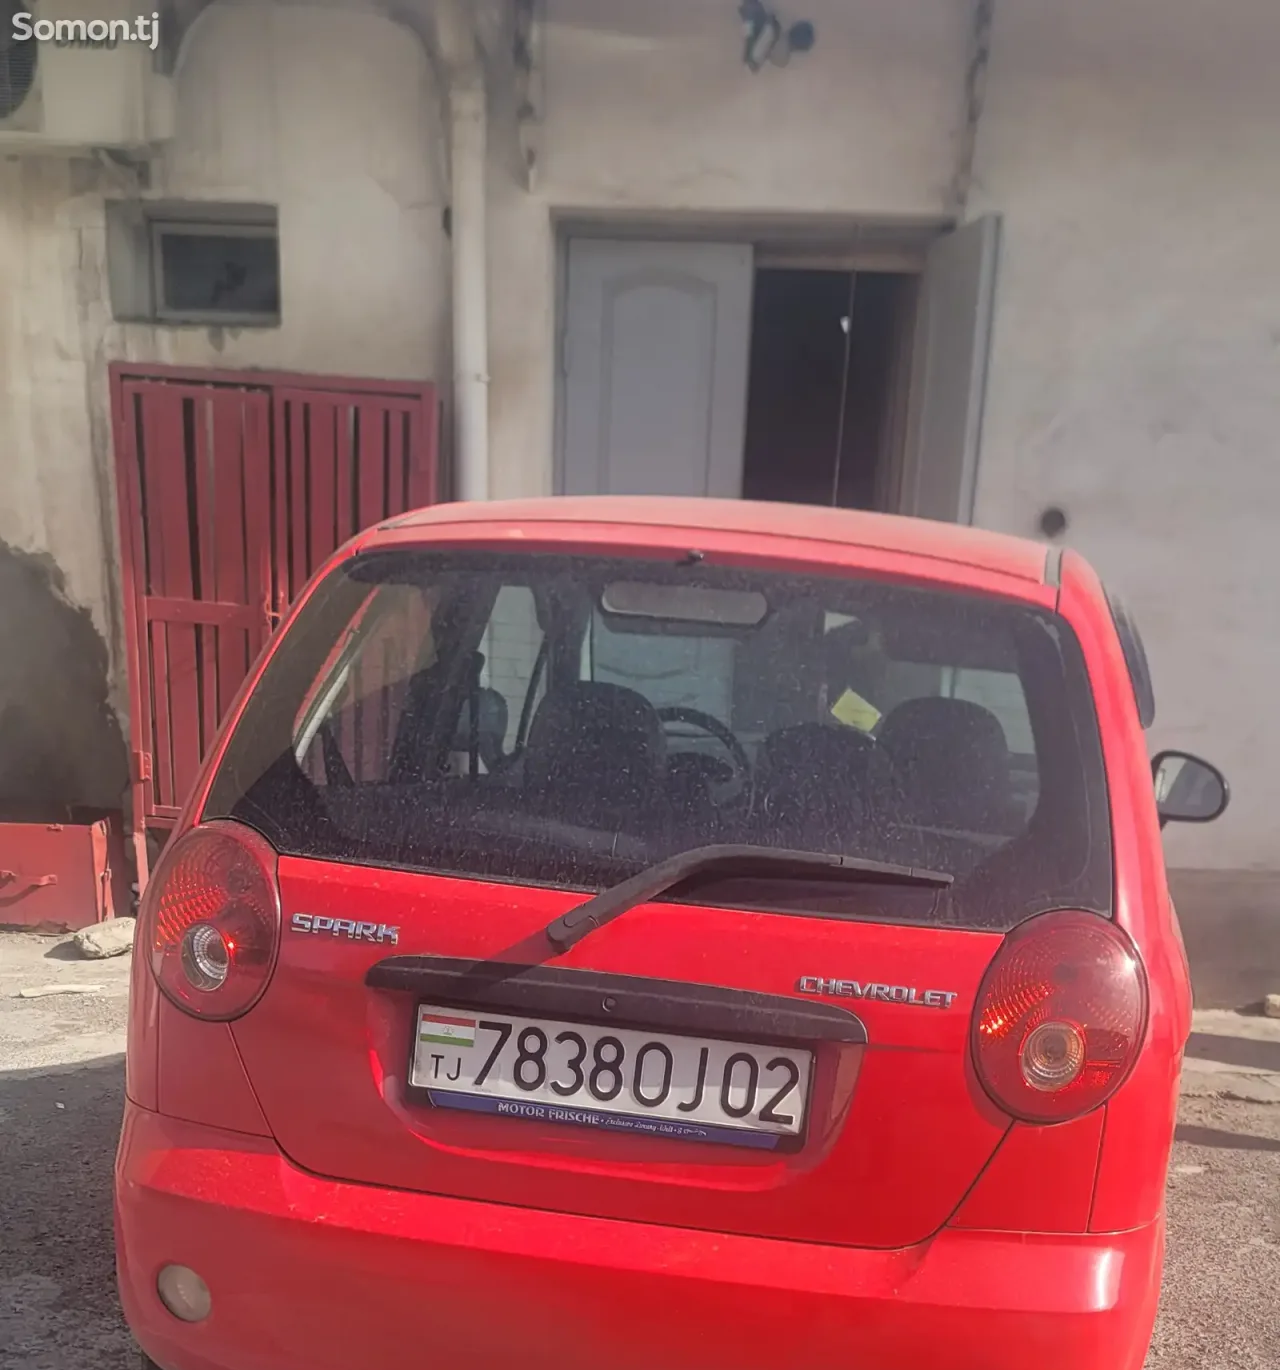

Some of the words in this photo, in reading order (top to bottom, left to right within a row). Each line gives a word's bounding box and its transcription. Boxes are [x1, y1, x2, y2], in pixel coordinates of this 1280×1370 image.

[291, 912, 401, 945] SPARK
[799, 975, 958, 1008] CHEVROLET
[431, 1053, 463, 1081] TJ
[497, 1101, 545, 1118] MOTOR
[548, 1109, 600, 1125] FRISCHE
